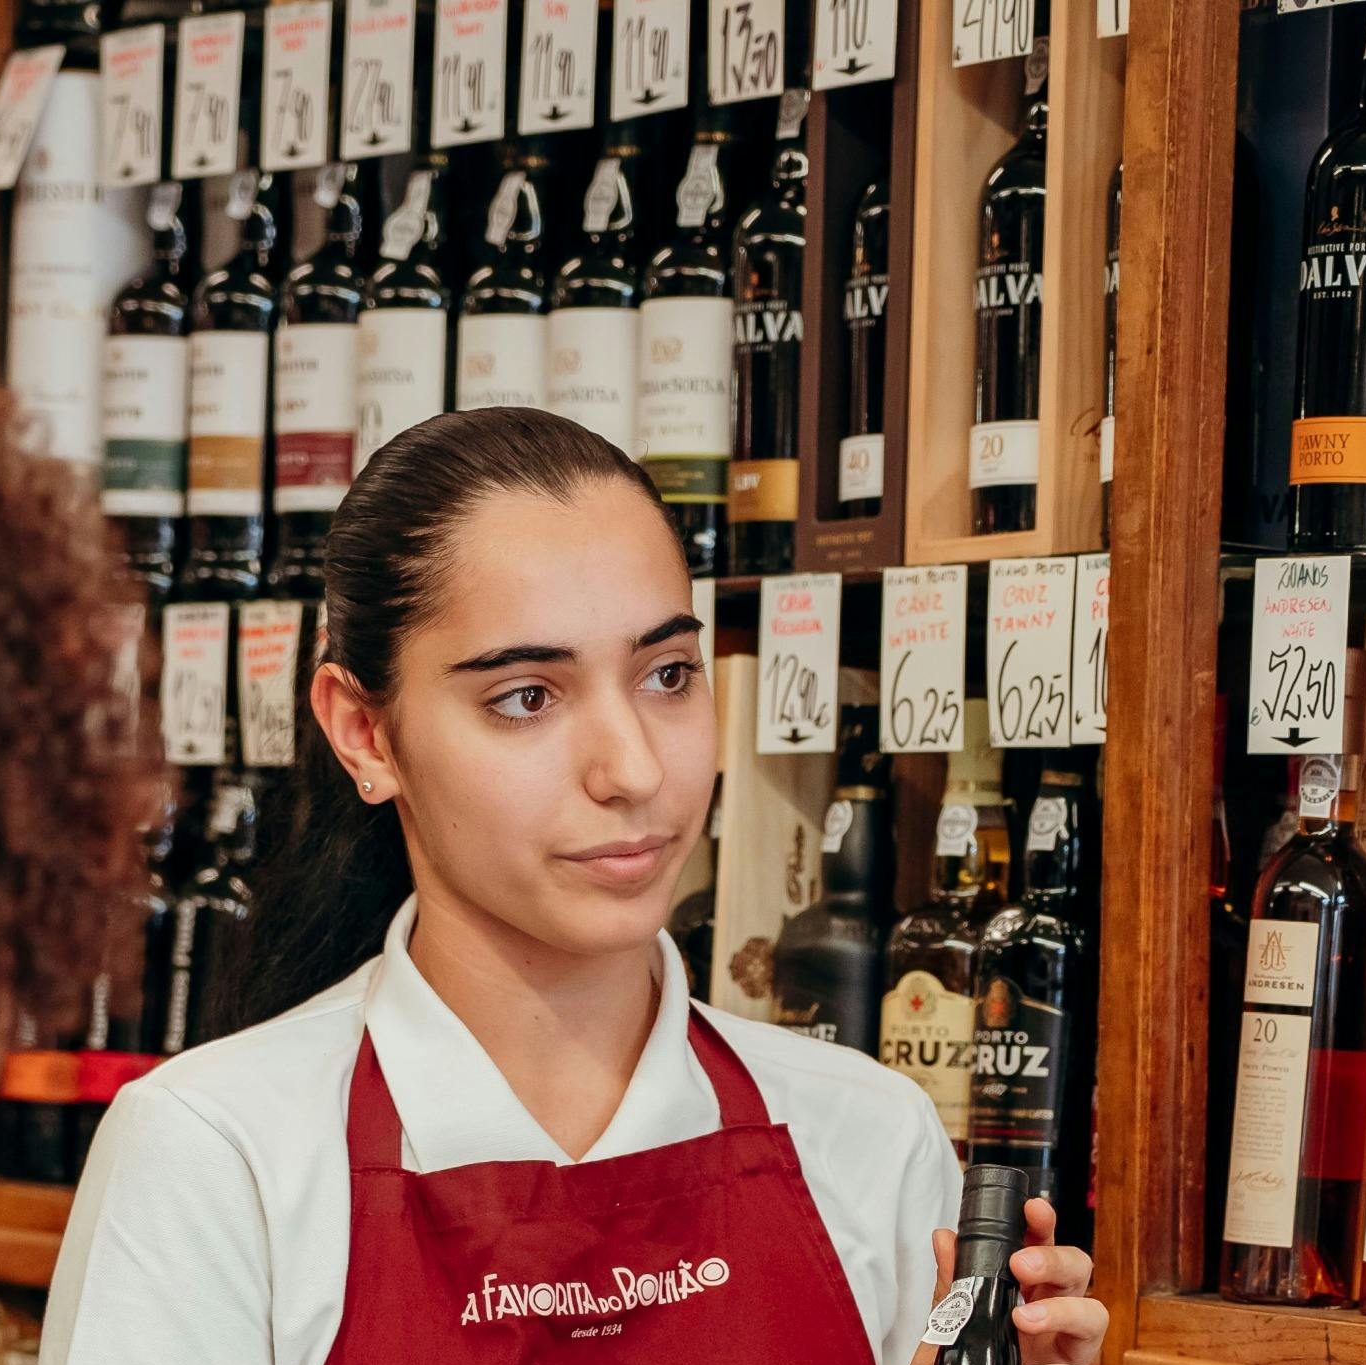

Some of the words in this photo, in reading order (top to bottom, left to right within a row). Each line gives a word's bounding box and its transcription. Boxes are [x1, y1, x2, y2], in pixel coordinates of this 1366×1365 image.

[979, 434, 1005, 460] 20
[1298, 433, 1351, 449] TAWNY
[1299, 450, 1345, 467] PORTO
[1002, 584, 1048, 608] CRUZ
[1262, 598, 1332, 617] ANDRESEN
[1262, 644, 1336, 722] 52.50
[1248, 979, 1306, 991] ANDRESEN
[974, 1030, 1029, 1045] PORTO
[1253, 1018, 1278, 1044] 20
[461, 1292, 481, 1326] A
[482, 1273, 600, 1322] FAVORITA
[598, 1296, 622, 1314] DO
[611, 1257, 730, 1311] BOLHÃO
[571, 1327, 599, 1338] desde
[601, 1323, 622, 1336] 1934
